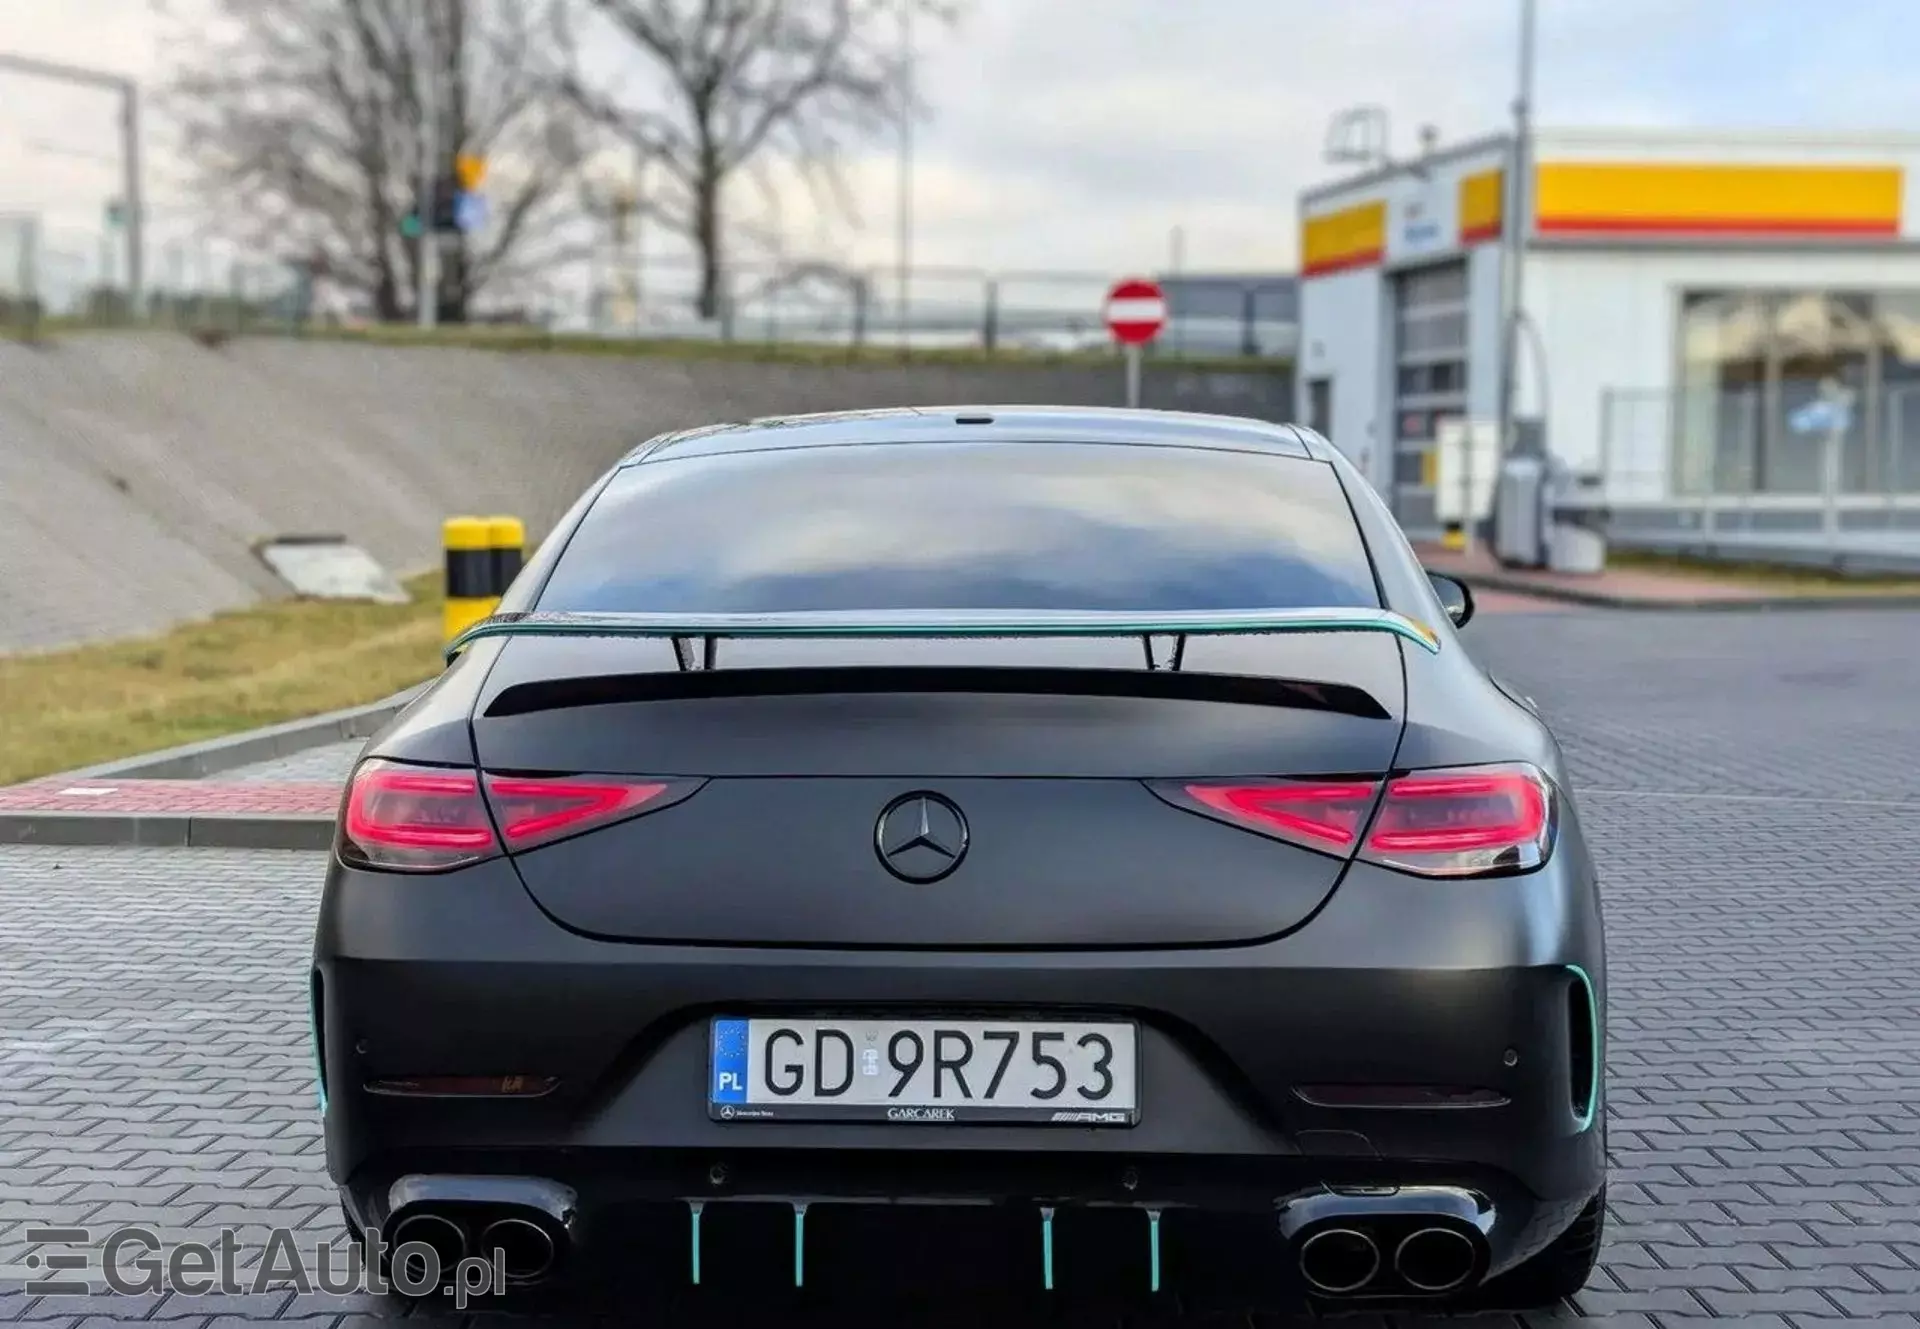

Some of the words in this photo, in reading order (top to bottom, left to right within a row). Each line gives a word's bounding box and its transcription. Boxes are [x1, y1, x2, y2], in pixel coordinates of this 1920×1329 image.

[764, 1028, 854, 1097] GD
[887, 1030, 1114, 1100] 9R753
[719, 1072, 743, 1090] PL
[887, 1107, 955, 1119] GARCAREK
[1075, 1112, 1125, 1122] AMG
